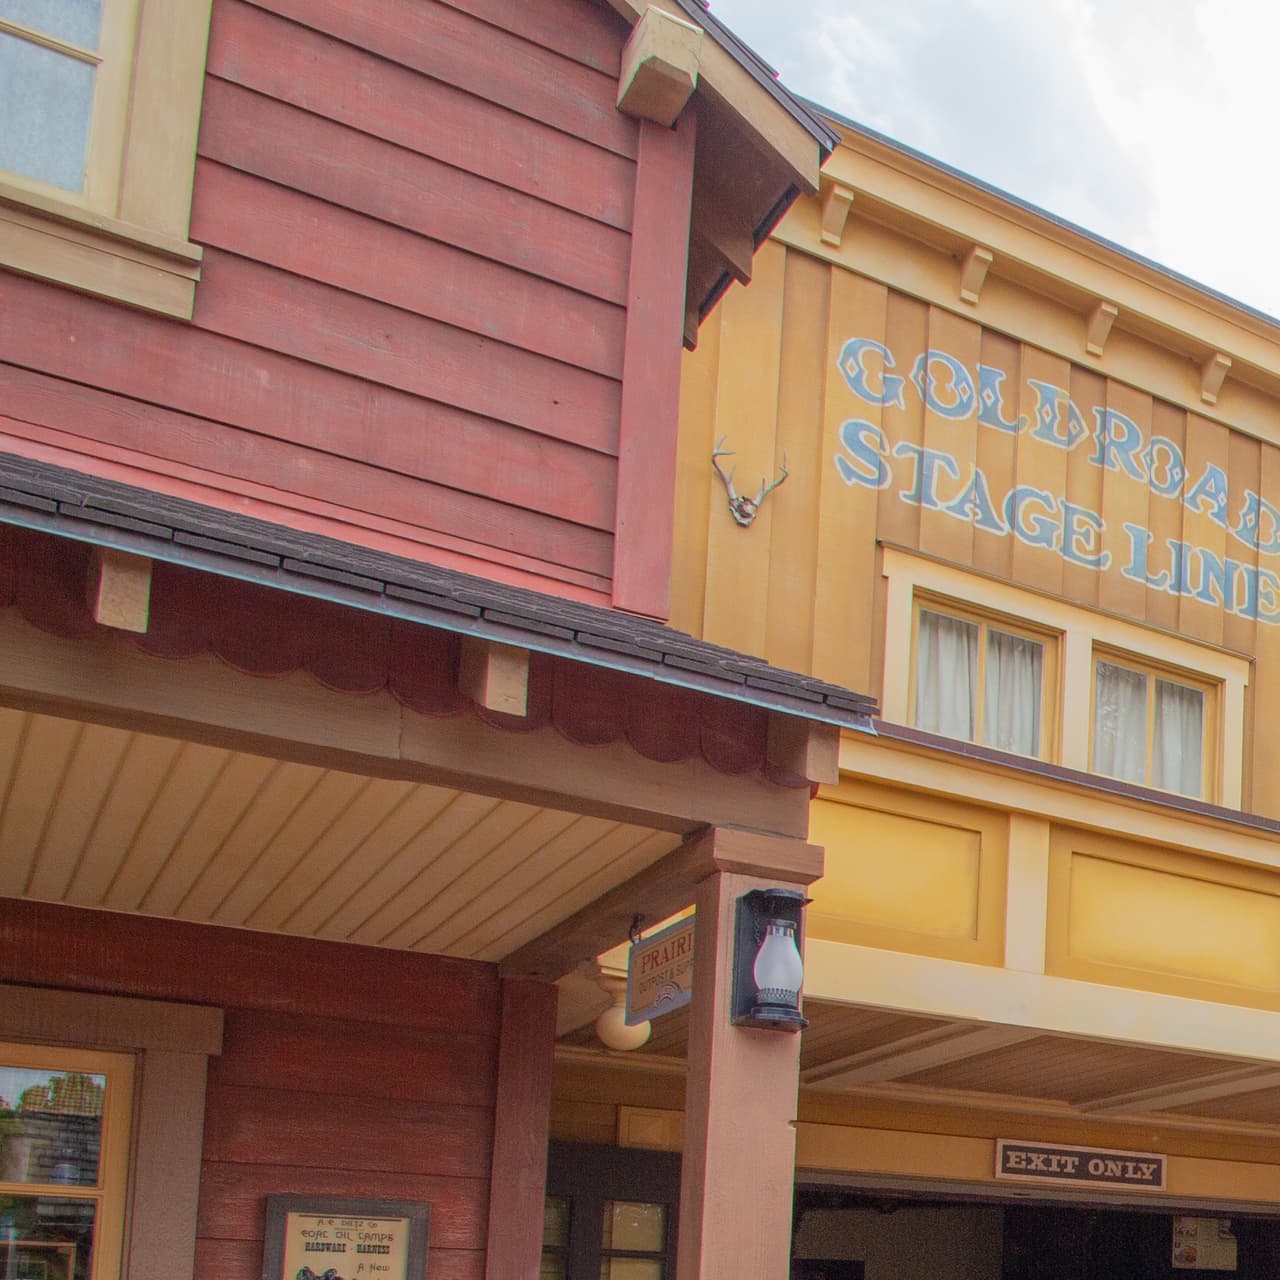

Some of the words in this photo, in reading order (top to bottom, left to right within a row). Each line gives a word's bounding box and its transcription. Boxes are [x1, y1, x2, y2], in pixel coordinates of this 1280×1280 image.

[835, 418, 1111, 571] STAGE
[641, 933, 693, 974] PRAIRI
[1006, 1151, 1079, 1174] EXIT
[1088, 1158, 1158, 1179] ONLY
[336, 1231, 353, 1242] OIL
[305, 1242, 347, 1253] HARDWARE
[357, 1243, 391, 1255] HARNESS
[357, 1263, 365, 1274] A
[370, 1262, 391, 1273] New
